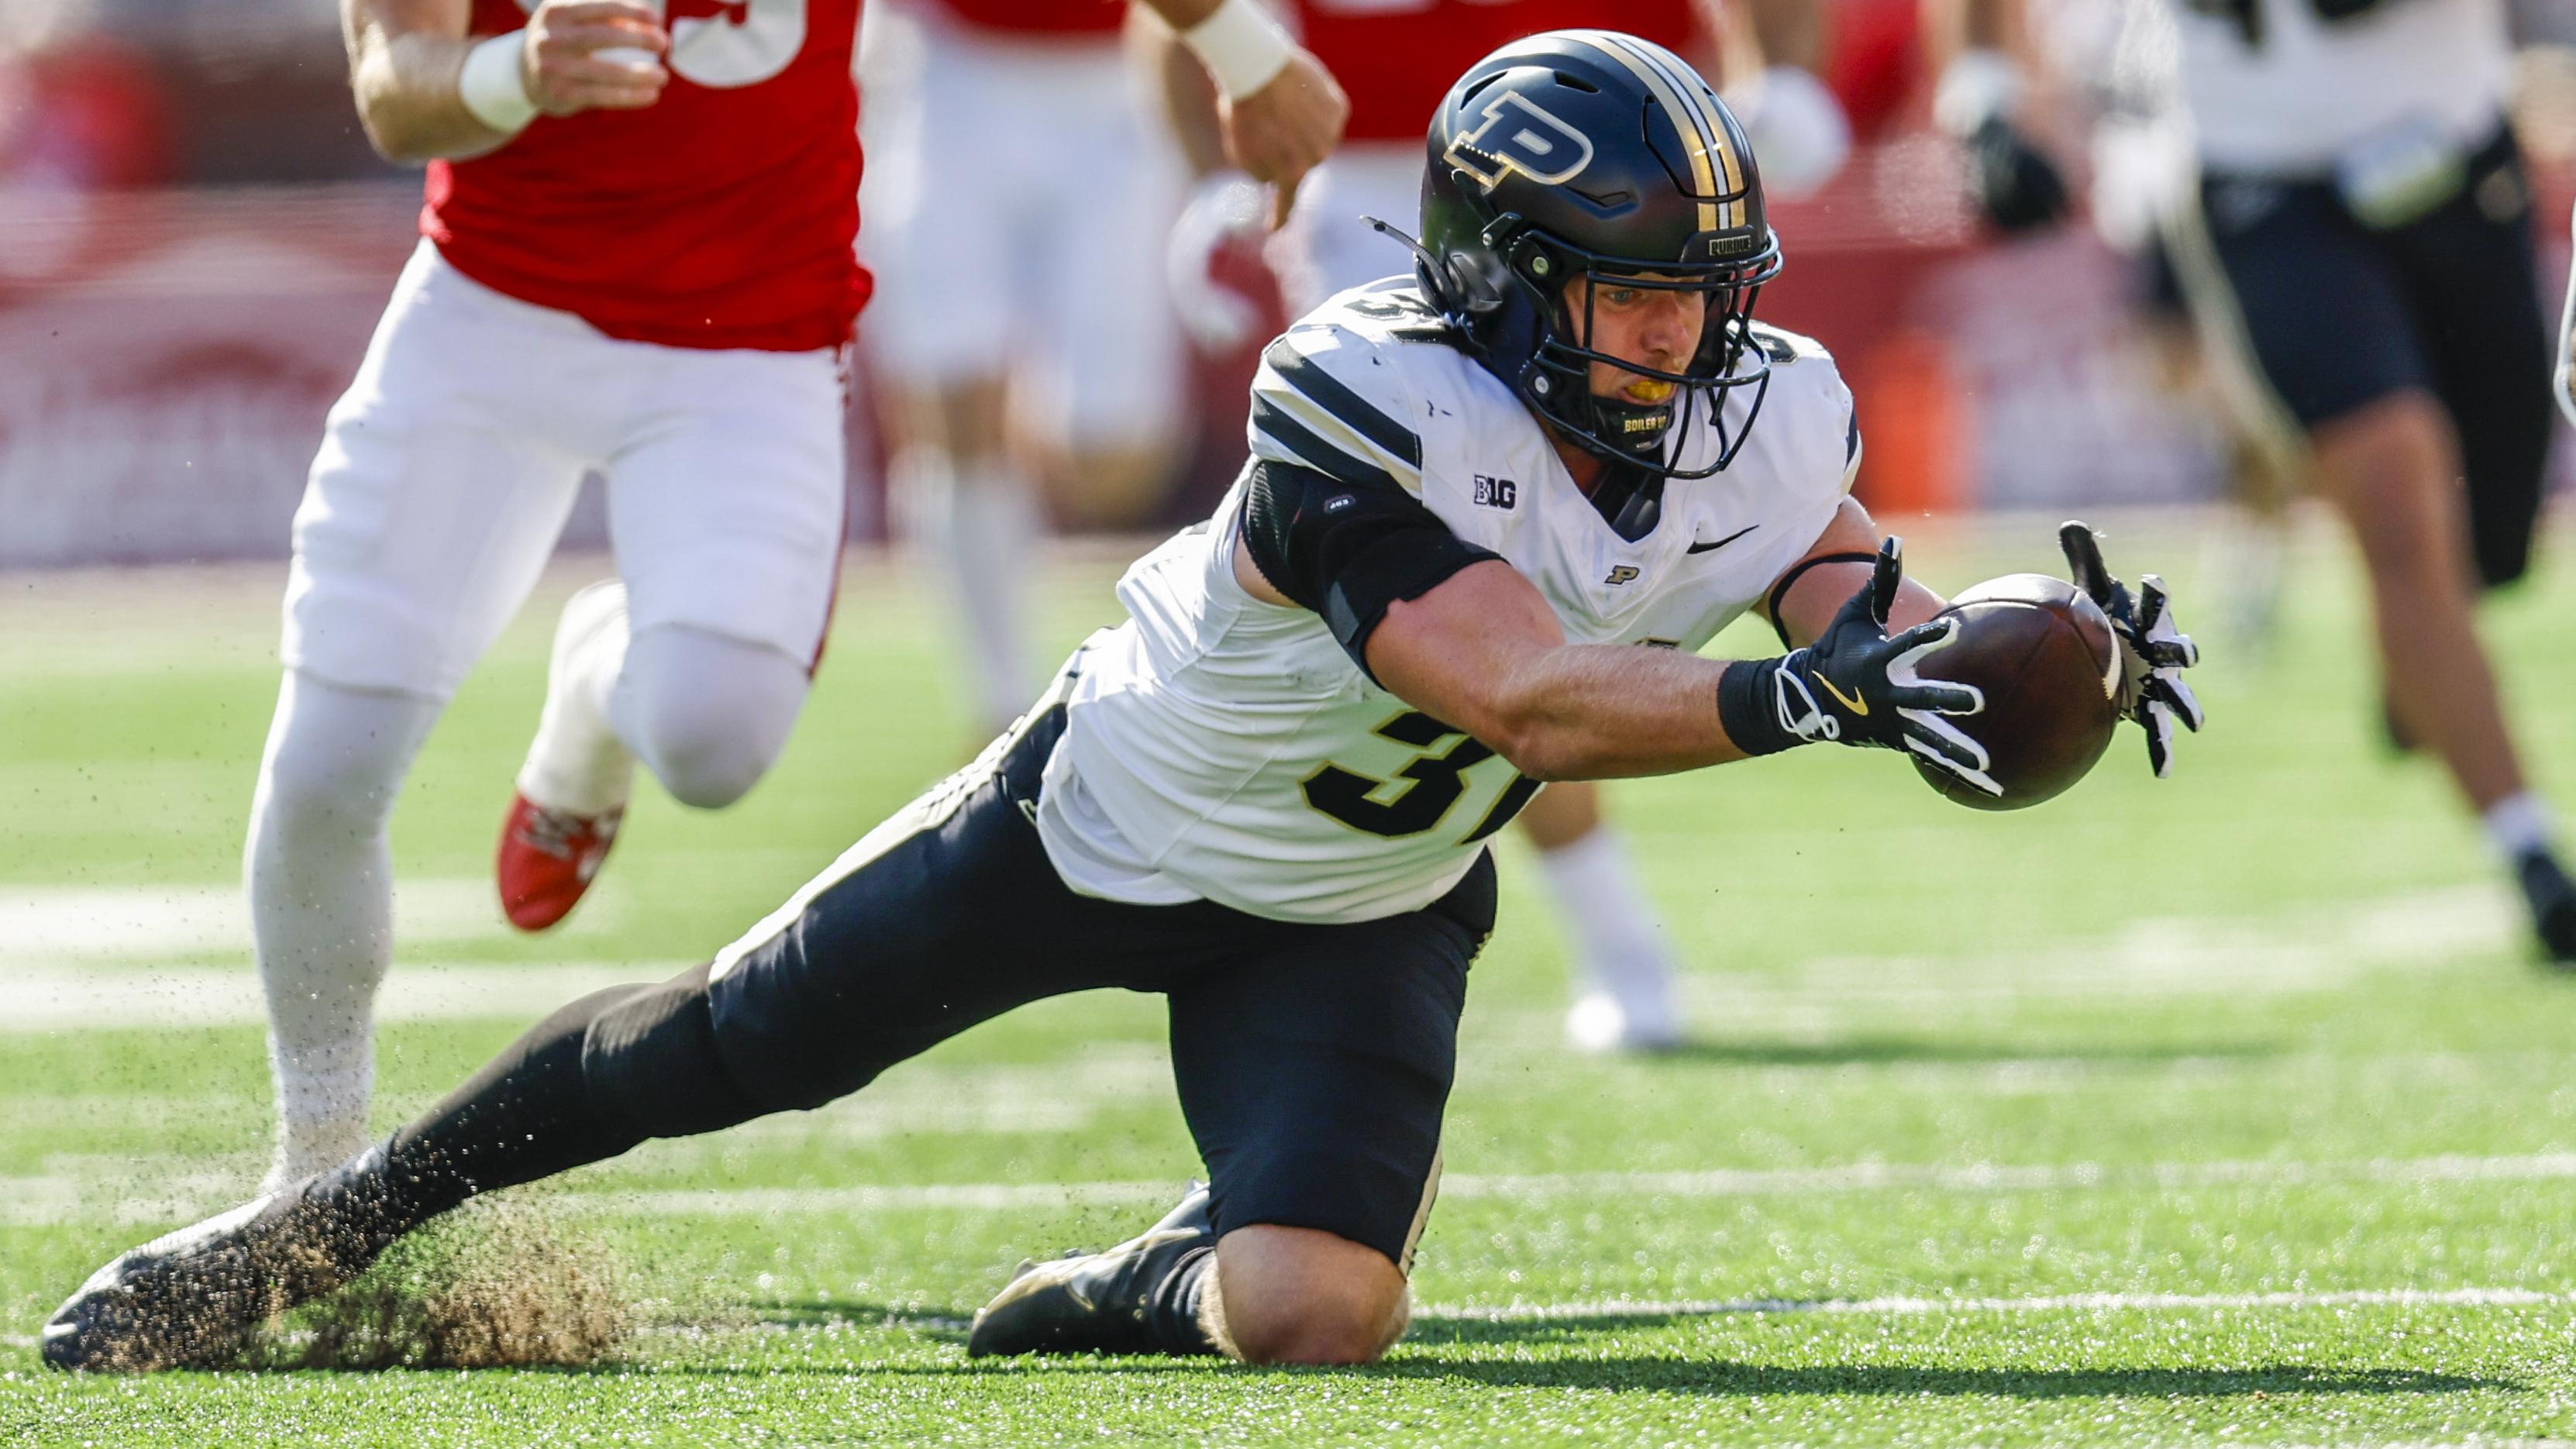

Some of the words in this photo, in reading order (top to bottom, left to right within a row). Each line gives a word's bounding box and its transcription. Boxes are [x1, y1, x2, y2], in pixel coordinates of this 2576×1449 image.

[1444, 90, 1593, 194] P
[1709, 235, 1751, 256] PURDUE
[1624, 417, 1657, 432] BOILER
[1603, 564, 1640, 586] P
